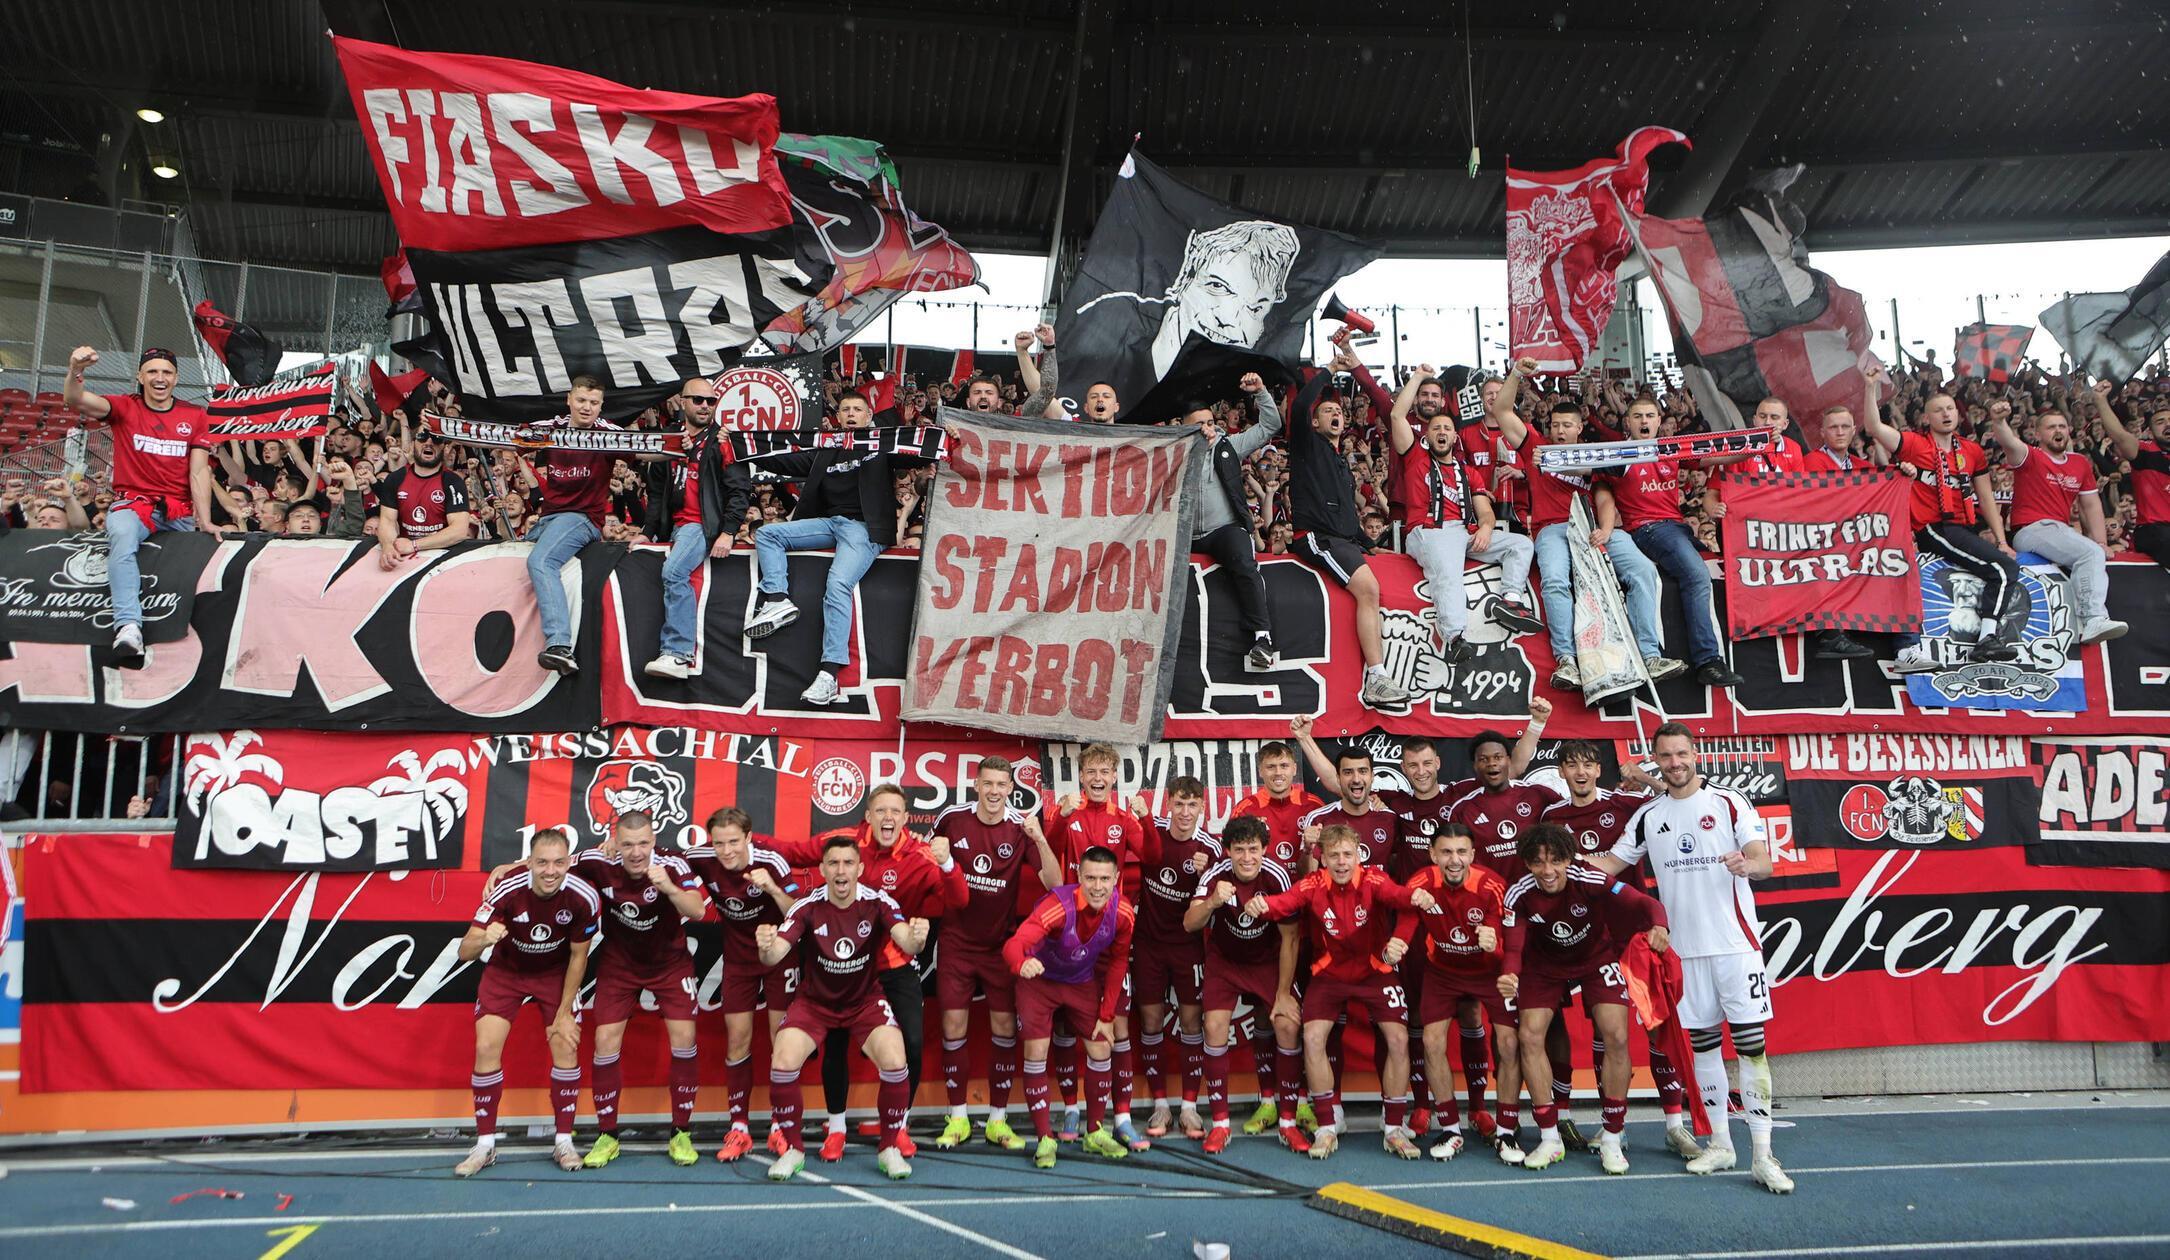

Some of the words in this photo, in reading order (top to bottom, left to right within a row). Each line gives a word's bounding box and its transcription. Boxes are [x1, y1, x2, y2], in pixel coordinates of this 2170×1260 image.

[209, 370, 335, 404] Nordkurve
[738, 384, 758, 407] 1.
[209, 408, 320, 437] Nürnberg
[720, 406, 777, 431] FCN
[134, 439, 188, 456] VEREIN
[943, 426, 1188, 521] SEKTION
[1746, 519, 1837, 552] FRIHET
[1840, 512, 1890, 545] FÖR
[930, 533, 1169, 614] STADION
[1736, 546, 1911, 587] ULTRAS
[916, 634, 1154, 724] VERBOT
[1461, 669, 1522, 694] 1994
[468, 726, 810, 779] WEISSACHTAL
[1789, 733, 1840, 769] DIE
[1846, 733, 2027, 772] BESESSENEN
[820, 782, 854, 797] FCN
[1850, 812, 1884, 832] FCN
[1382, 985, 1408, 1009] 32
